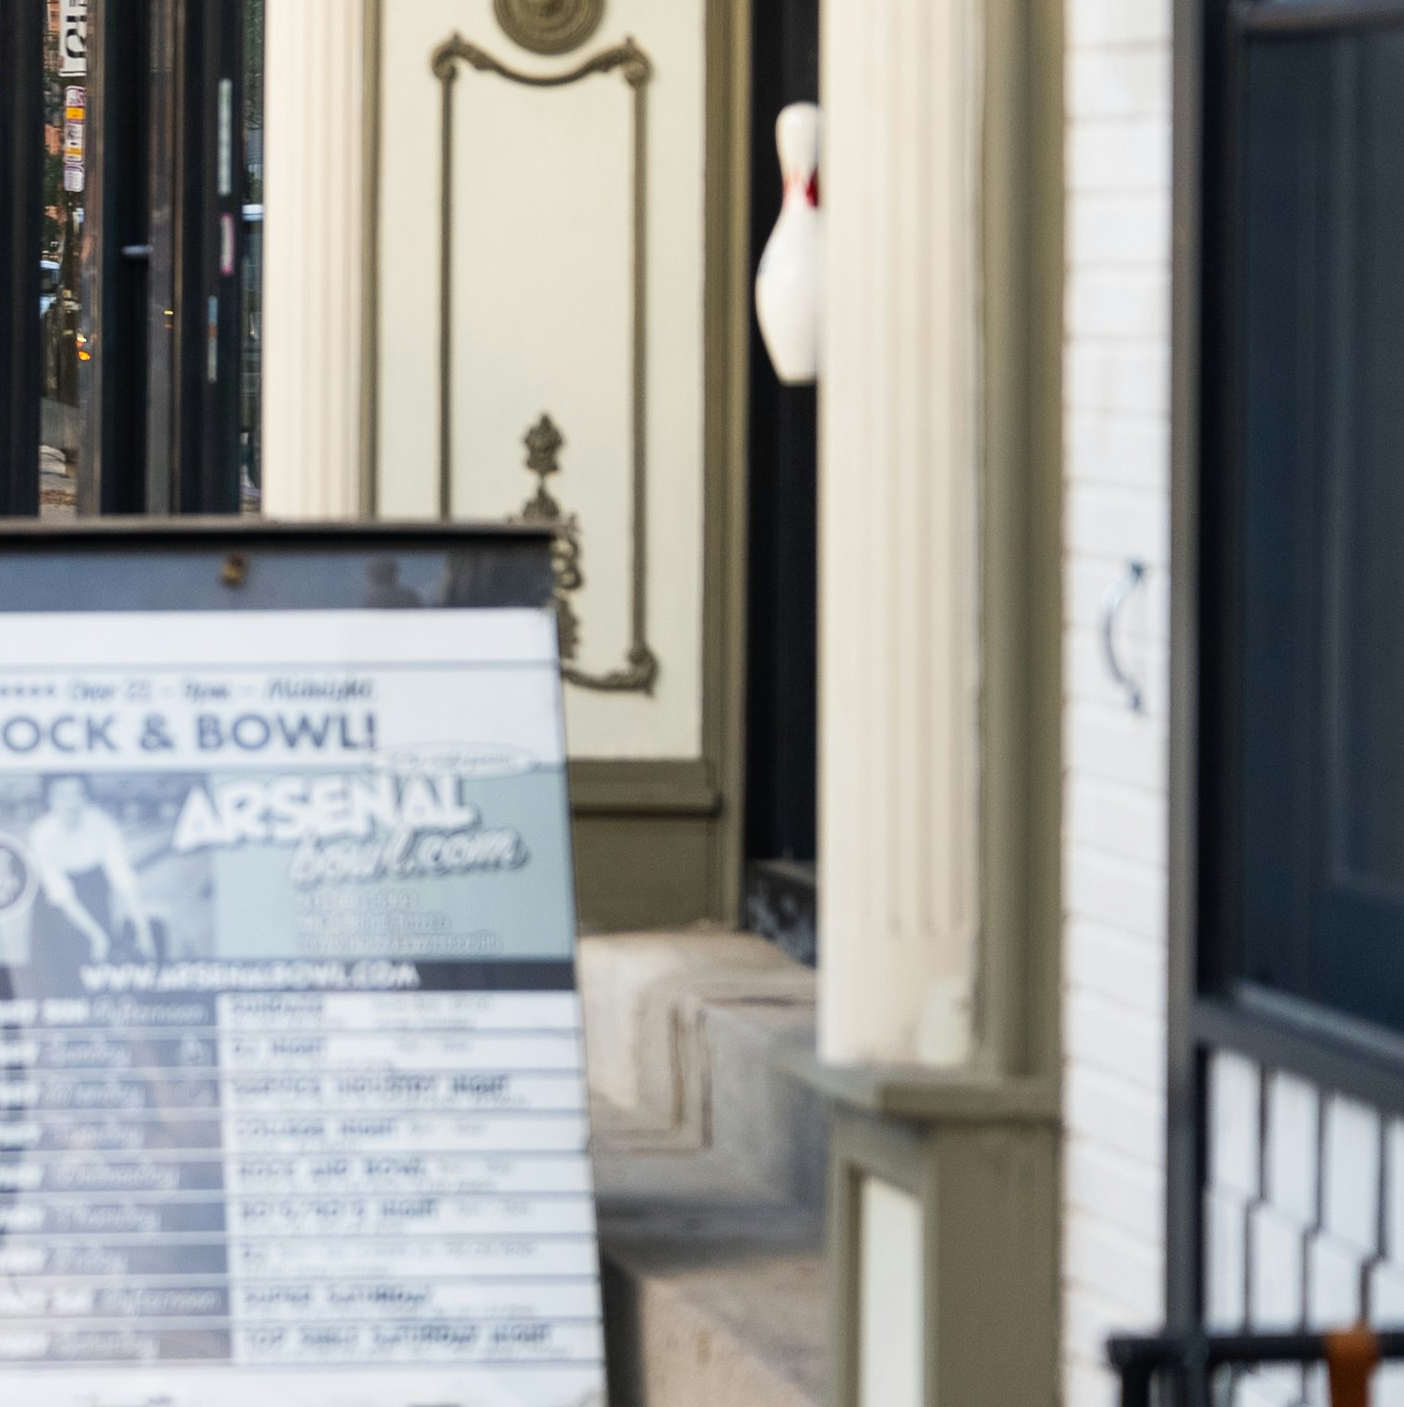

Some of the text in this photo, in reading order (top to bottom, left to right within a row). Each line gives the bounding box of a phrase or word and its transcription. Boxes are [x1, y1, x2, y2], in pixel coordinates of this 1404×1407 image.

[138, 714, 176, 752] &
[196, 712, 378, 753] BOWL!
[172, 769, 479, 853] ARSENAL
